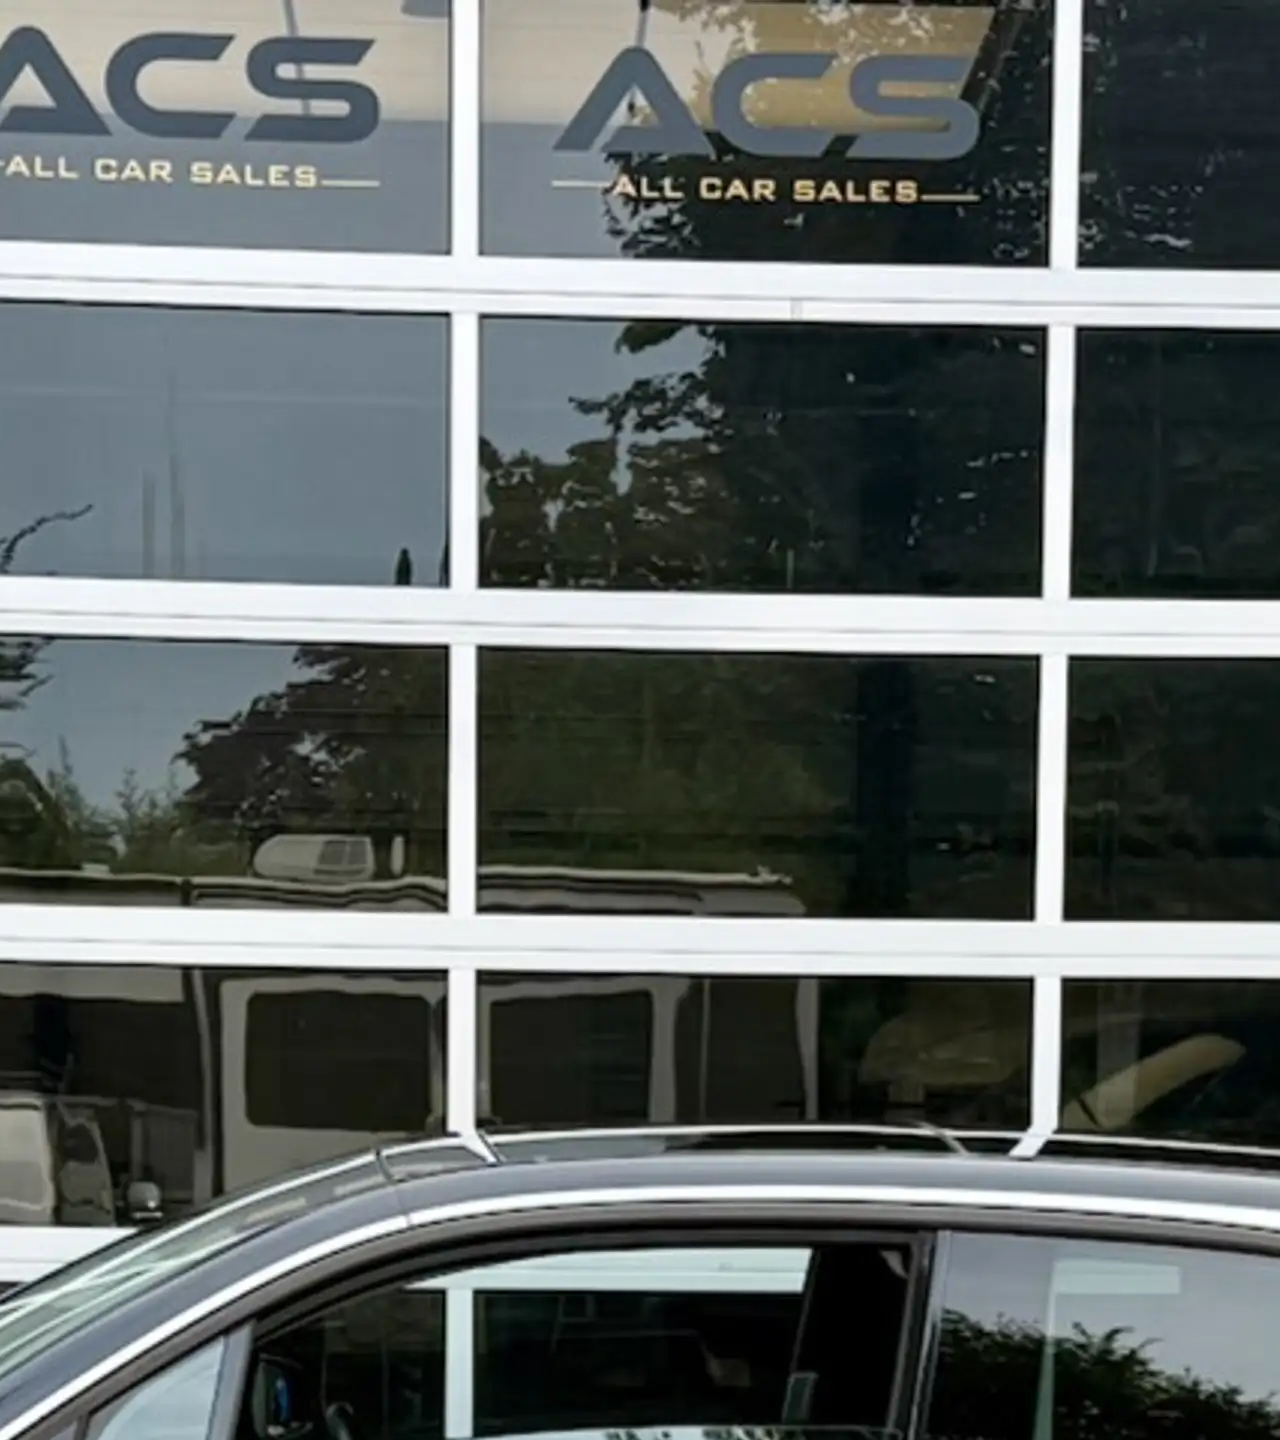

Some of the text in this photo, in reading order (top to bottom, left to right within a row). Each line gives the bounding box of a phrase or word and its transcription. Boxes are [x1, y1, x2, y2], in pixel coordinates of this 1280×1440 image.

[552, 44, 981, 161] ACS
[4, 155, 320, 189] ALL CAR SALES
[610, 176, 921, 204] ALL CAR SALES
